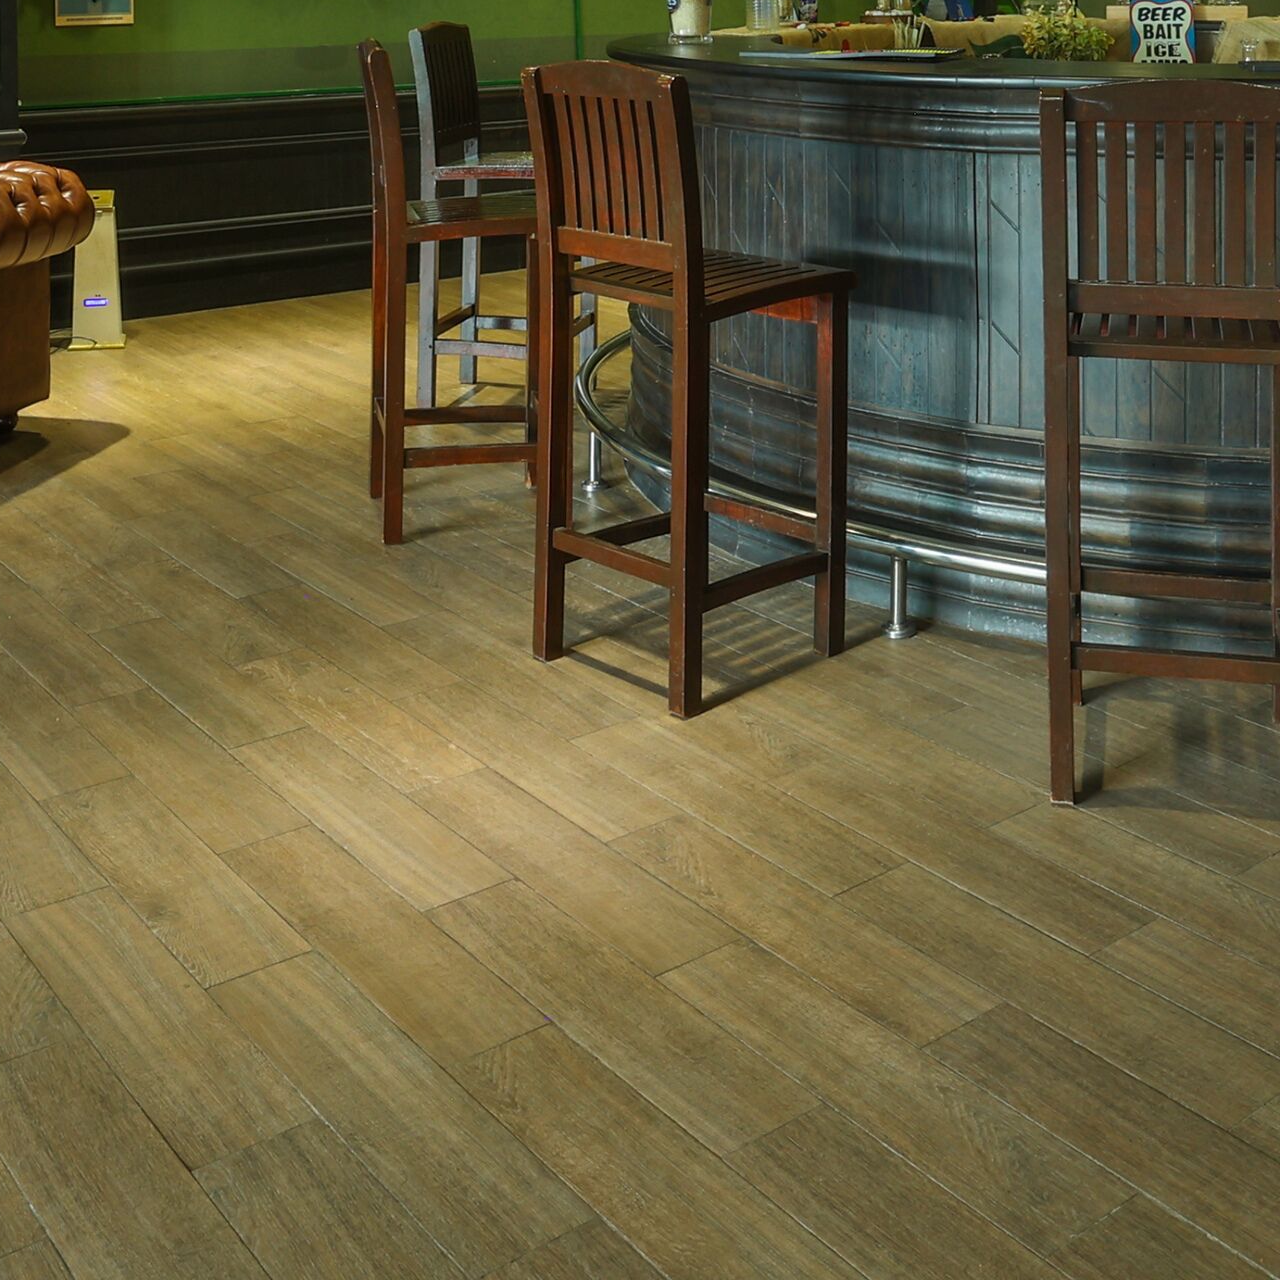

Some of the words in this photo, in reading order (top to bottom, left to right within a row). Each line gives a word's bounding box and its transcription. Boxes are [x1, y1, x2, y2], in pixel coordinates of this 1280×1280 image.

[1138, 7, 1187, 22] BEER
[1143, 24, 1183, 39] BAIT
[1146, 41, 1182, 57] ICE
